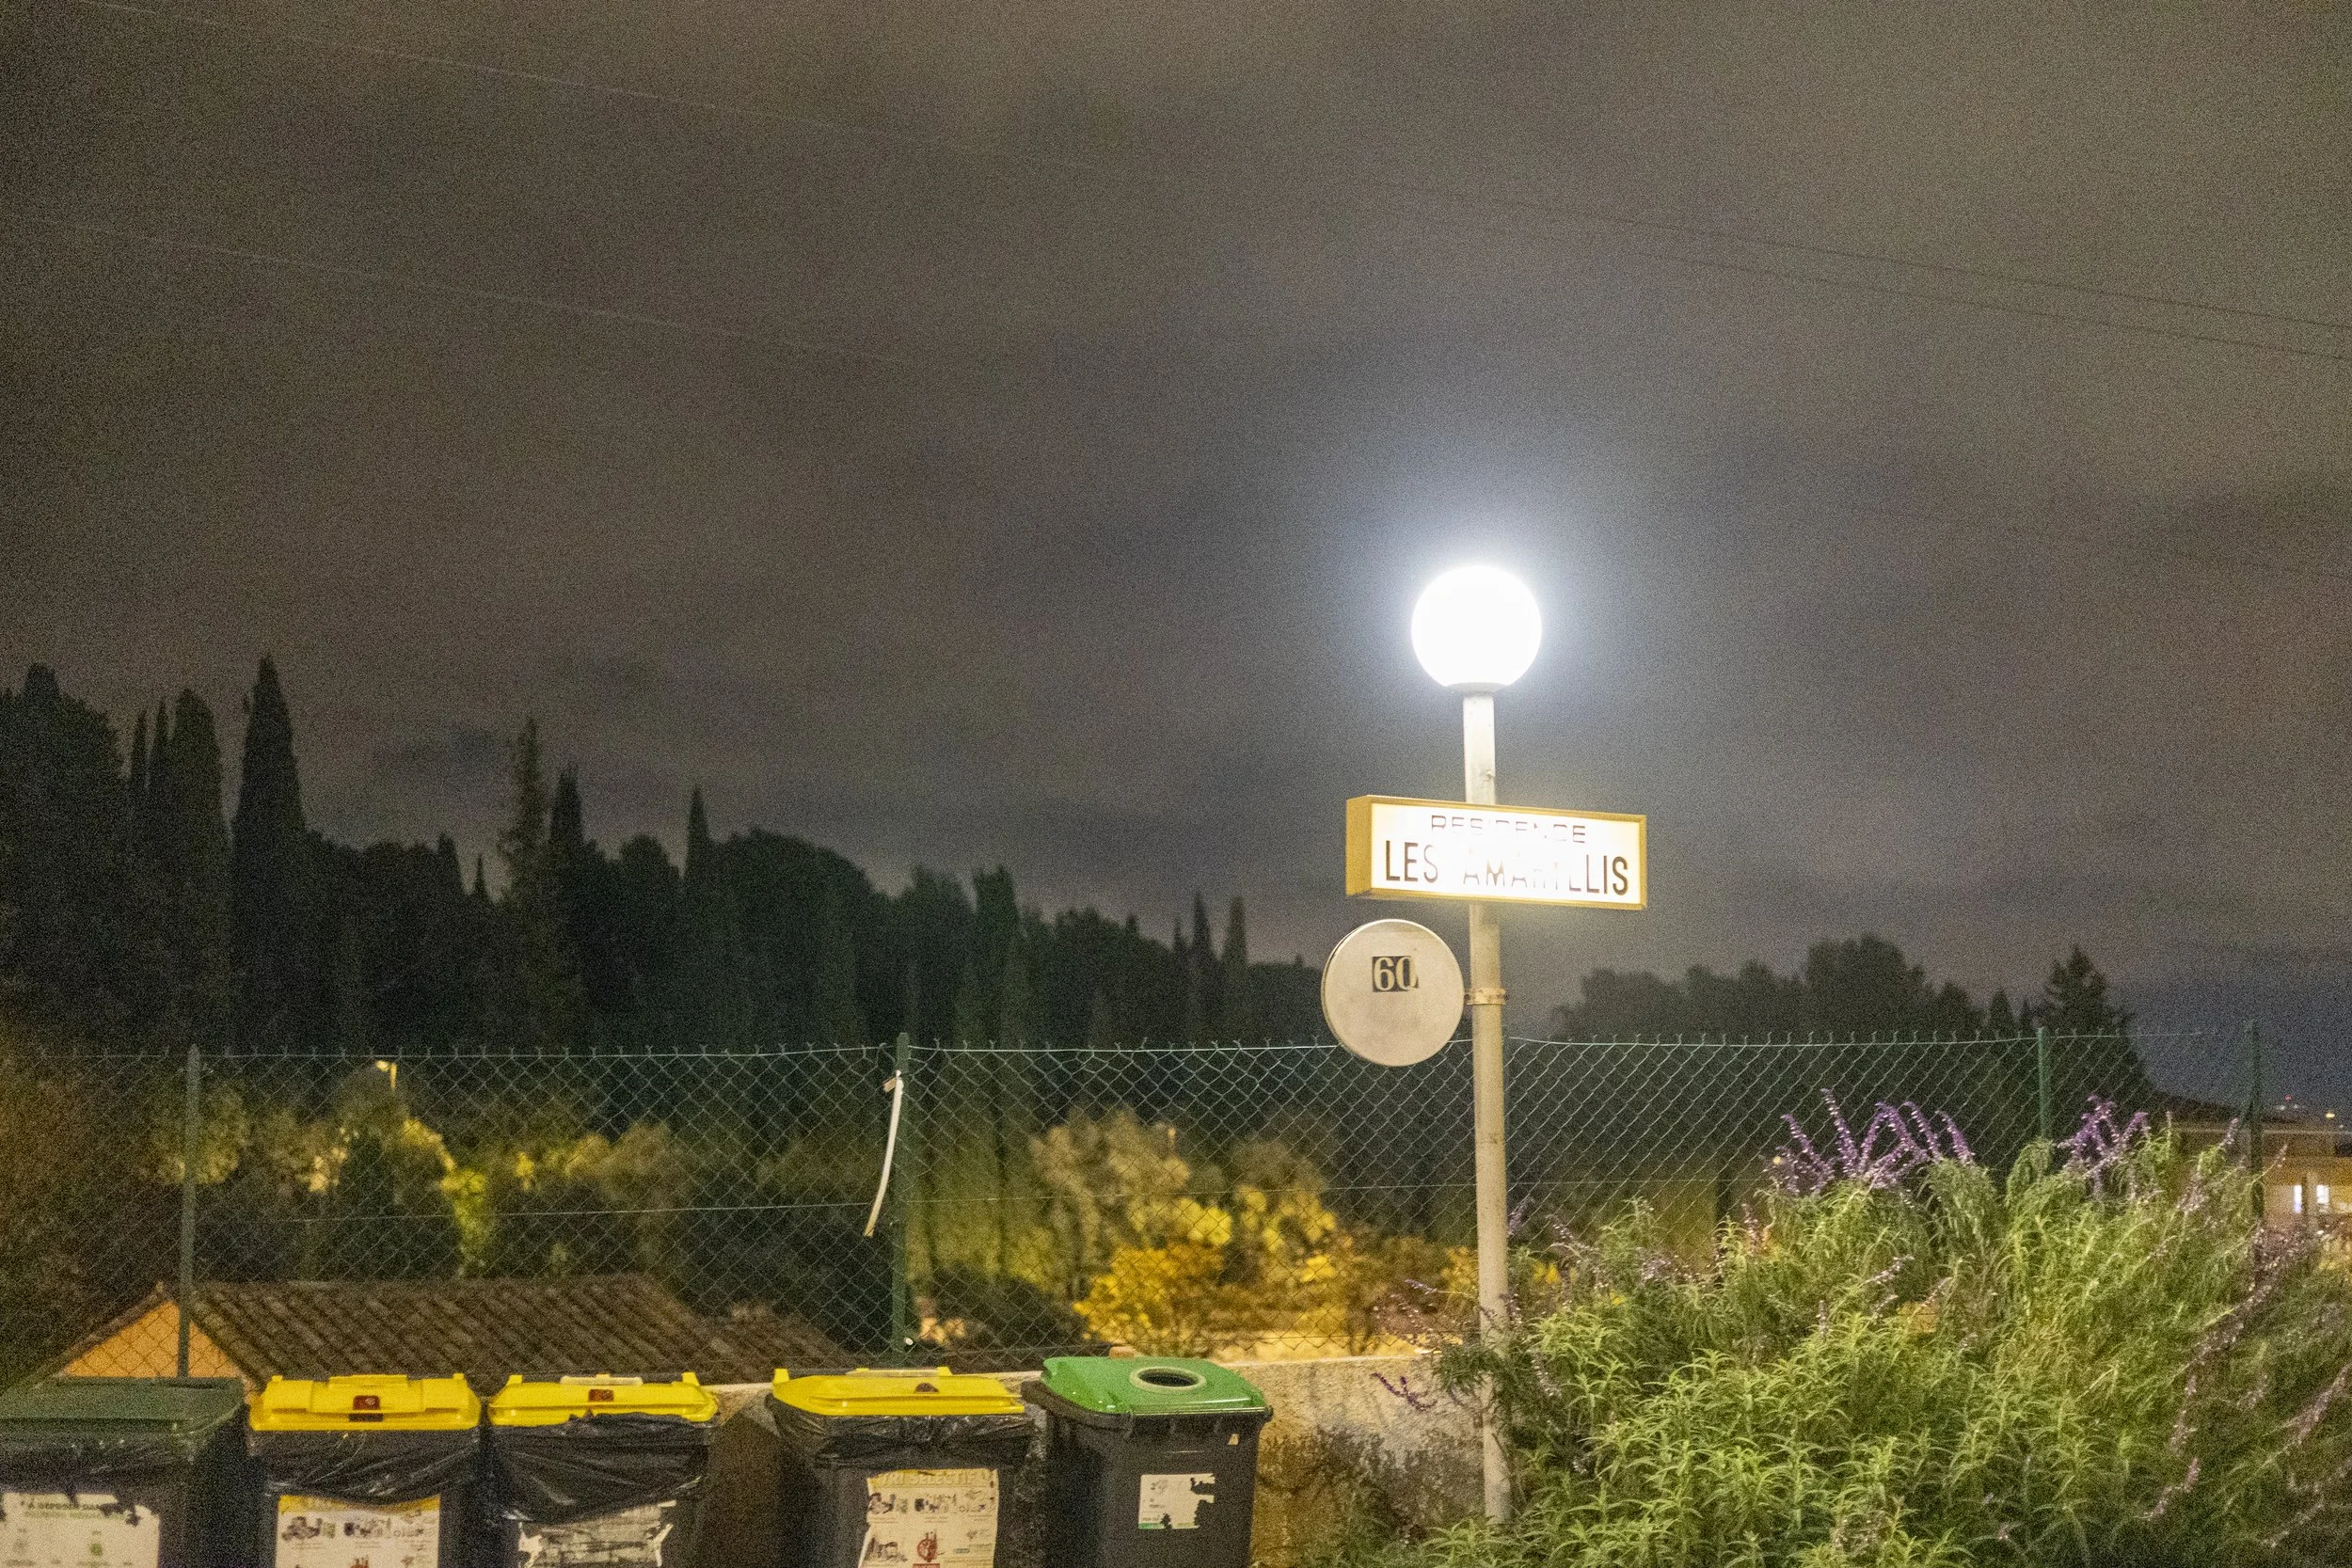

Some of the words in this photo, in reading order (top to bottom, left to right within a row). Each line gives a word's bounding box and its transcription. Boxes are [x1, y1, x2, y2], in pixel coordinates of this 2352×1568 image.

[1430, 814, 1587, 845] RESECE
[1384, 838, 1439, 884] LES
[1373, 956, 1418, 992] 60
